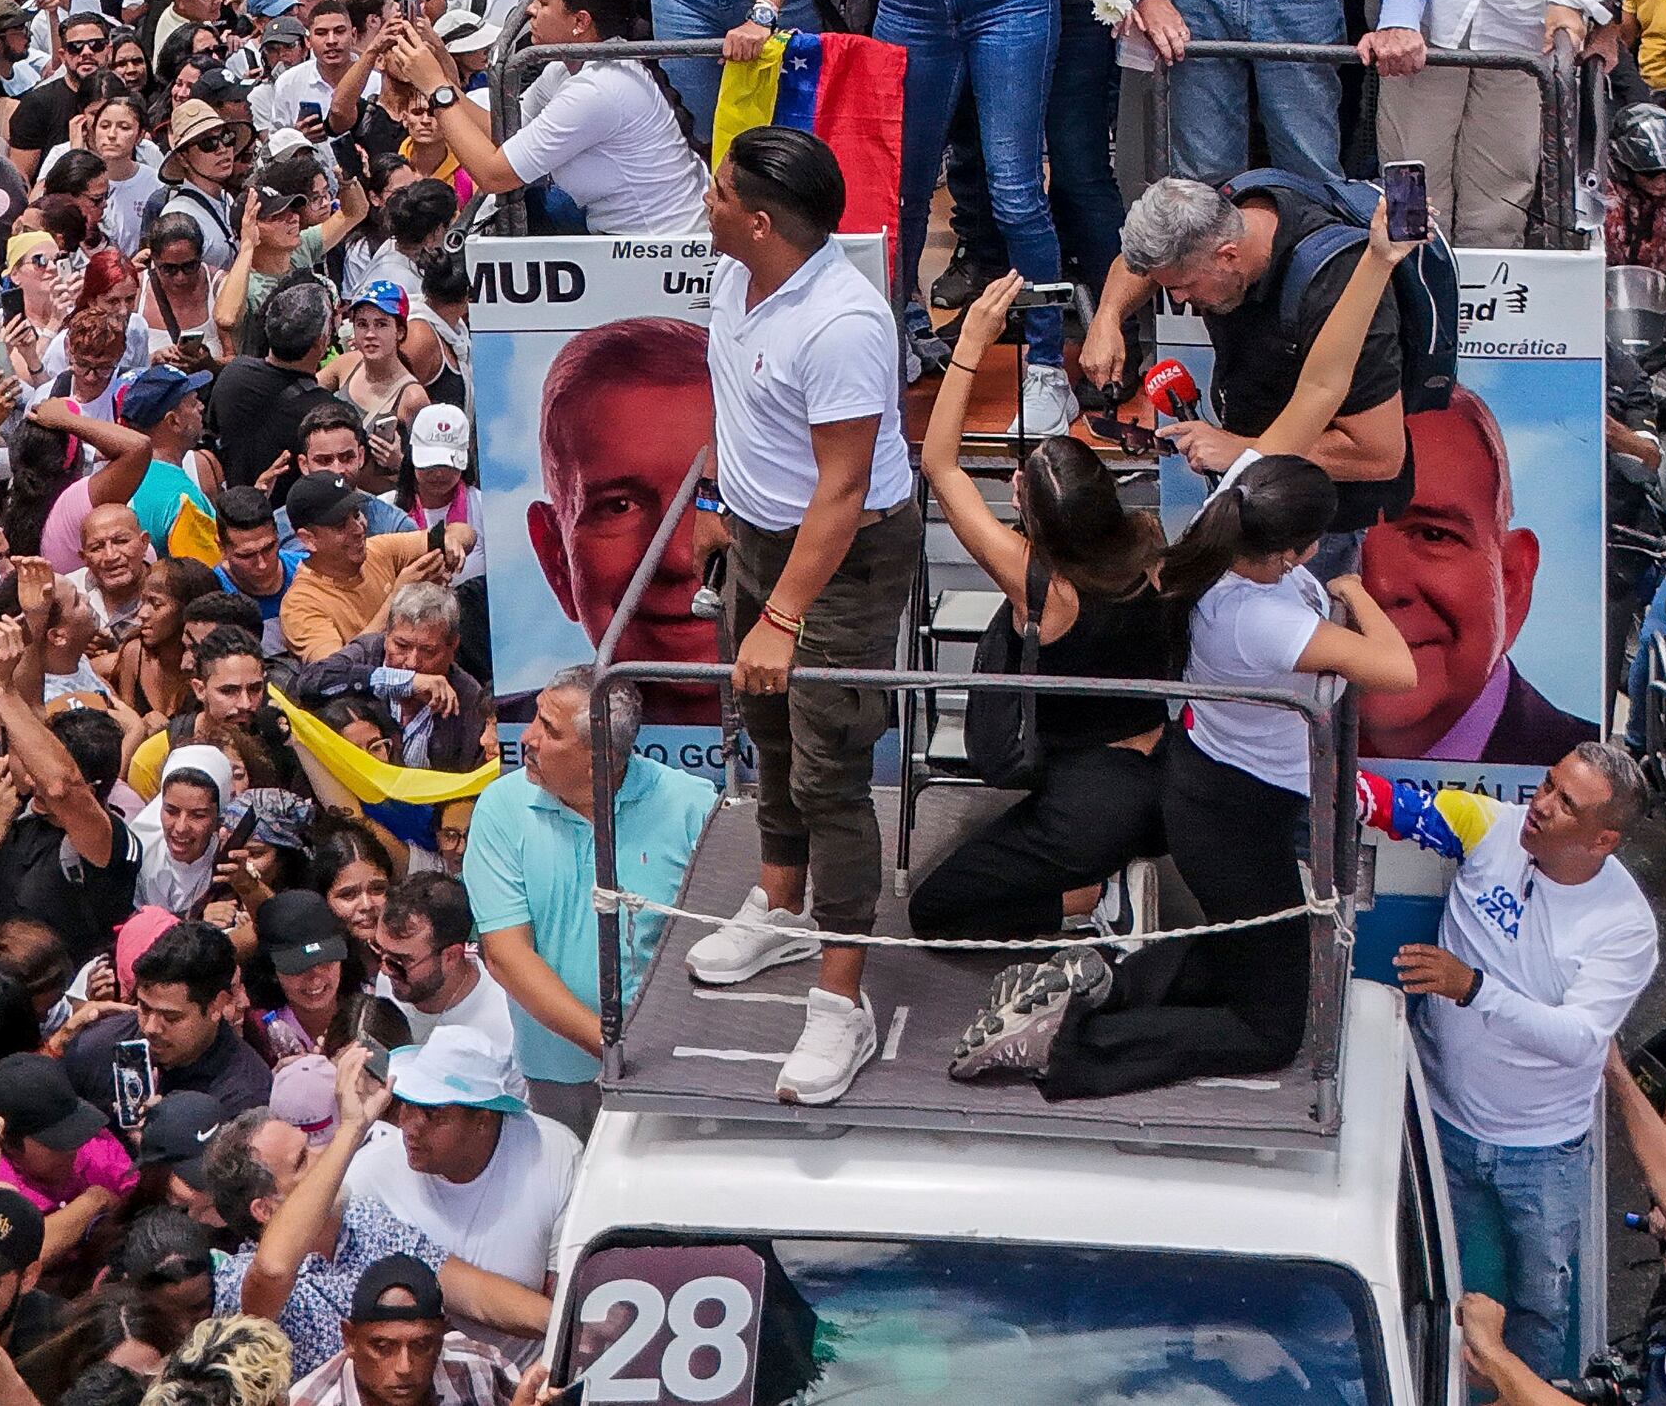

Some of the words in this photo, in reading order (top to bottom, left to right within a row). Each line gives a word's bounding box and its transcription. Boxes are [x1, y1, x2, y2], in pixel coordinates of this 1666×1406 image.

[612, 240, 673, 260] Mesa
[681, 240, 707, 259] de
[469, 261, 586, 304] MUD
[1491, 884, 1524, 920] CON
[579, 1274, 754, 1403] 28
